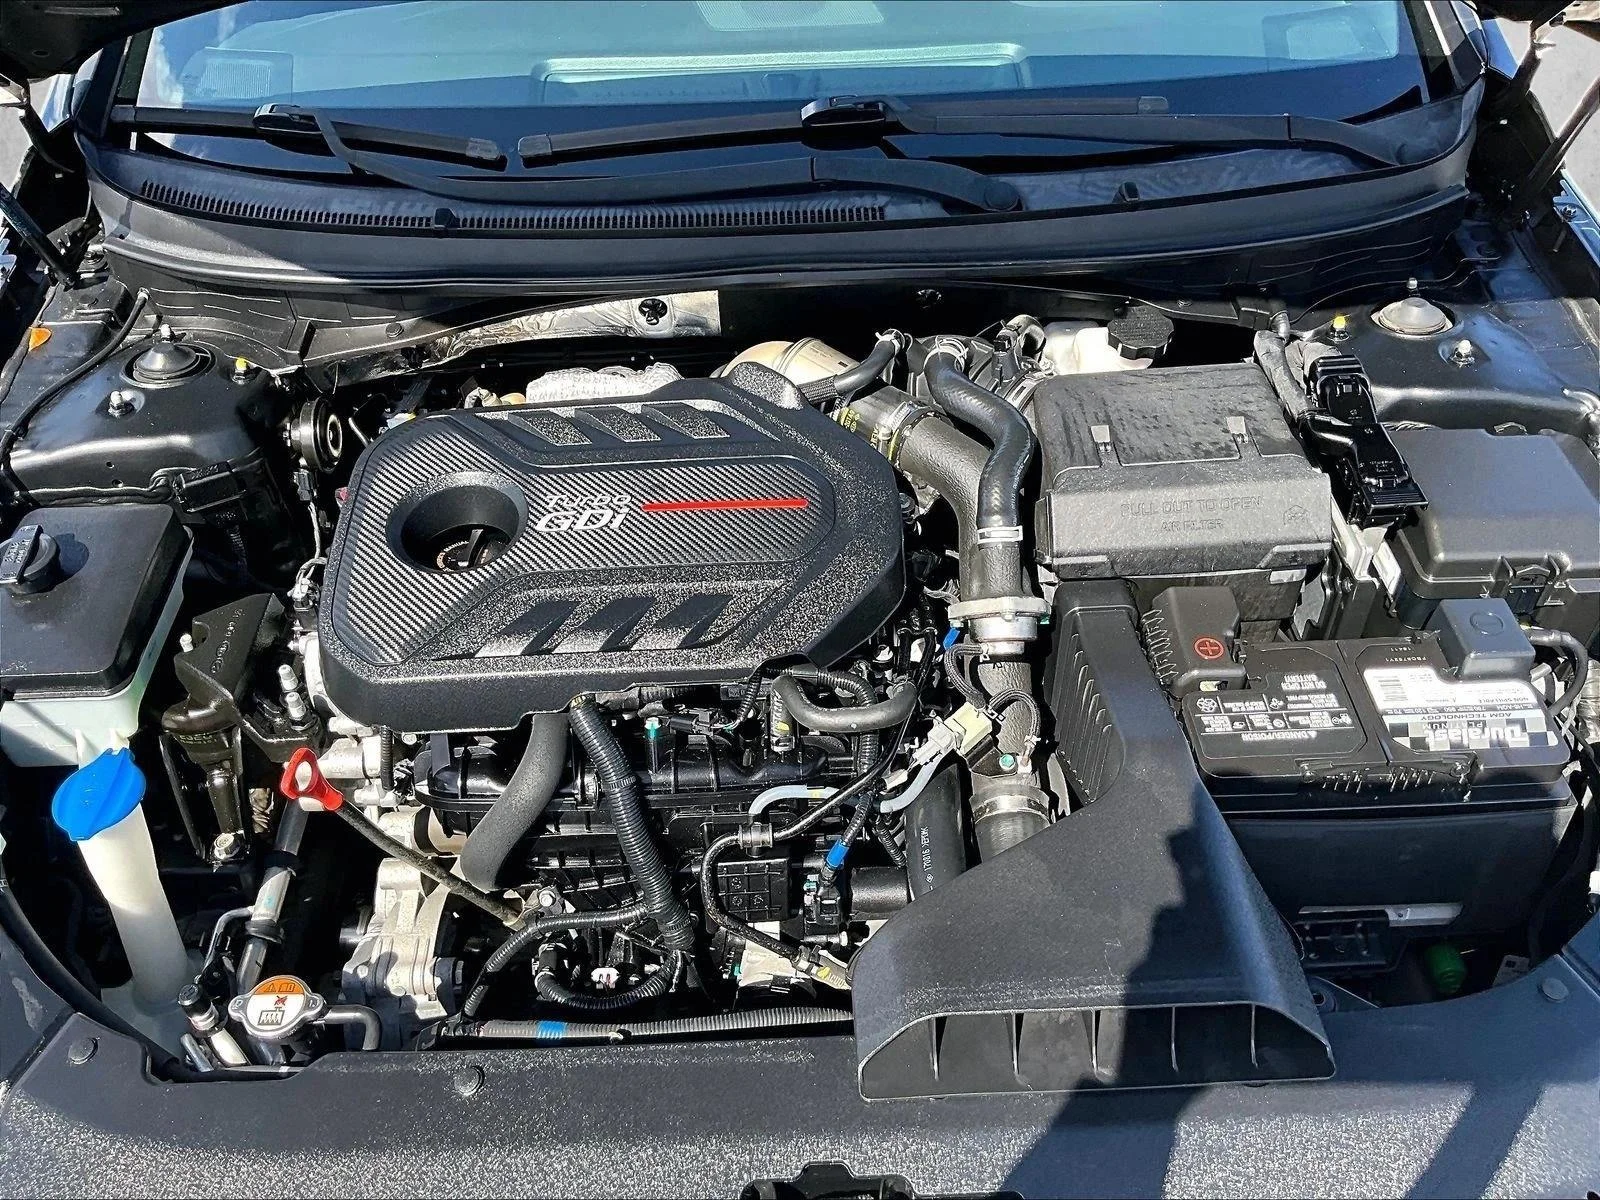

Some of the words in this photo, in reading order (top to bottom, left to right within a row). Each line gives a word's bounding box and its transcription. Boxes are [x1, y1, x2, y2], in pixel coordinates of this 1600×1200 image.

[1120, 502, 1158, 518] PULL
[1162, 499, 1193, 515] OUT
[1196, 498, 1216, 513] TO
[1220, 495, 1263, 511] OPEN
[534, 507, 630, 532] GDi
[1420, 713, 1487, 721] TECHNOLOGY
[1422, 721, 1483, 730] PLATINUM
